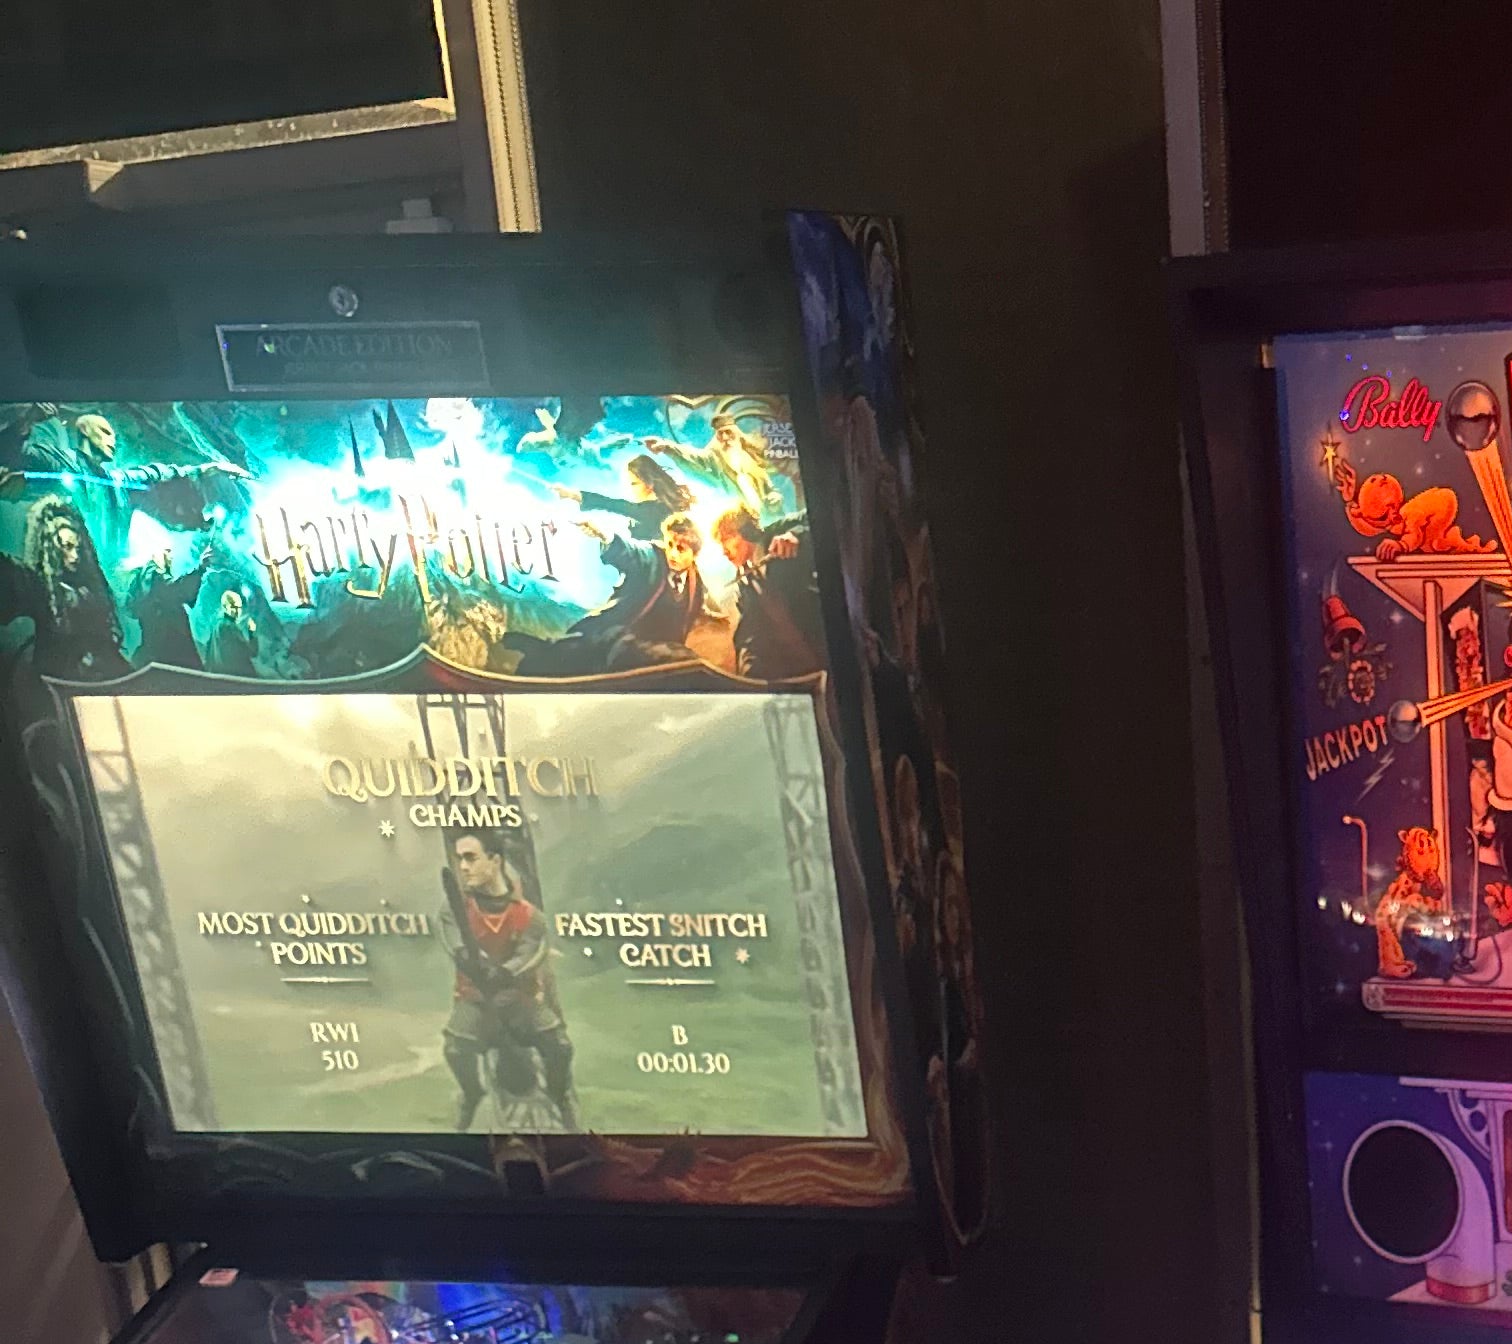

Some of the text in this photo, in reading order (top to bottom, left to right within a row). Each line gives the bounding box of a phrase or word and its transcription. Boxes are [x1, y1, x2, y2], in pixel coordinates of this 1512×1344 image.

[1338, 375, 1442, 443] Bally
[252, 507, 397, 609] Harry
[1304, 714, 1389, 782] JACKPOT
[322, 755, 599, 803] QUIDDITCH
[408, 803, 523, 828] CHAMPS
[197, 911, 431, 938] MOST QUIDDITCH
[554, 912, 769, 938] FASTEST SNITCH
[270, 942, 368, 966] POINTS
[618, 943, 713, 968] CATCH
[309, 1021, 361, 1044] RWI
[671, 1024, 689, 1046] B
[321, 1050, 360, 1071] 510
